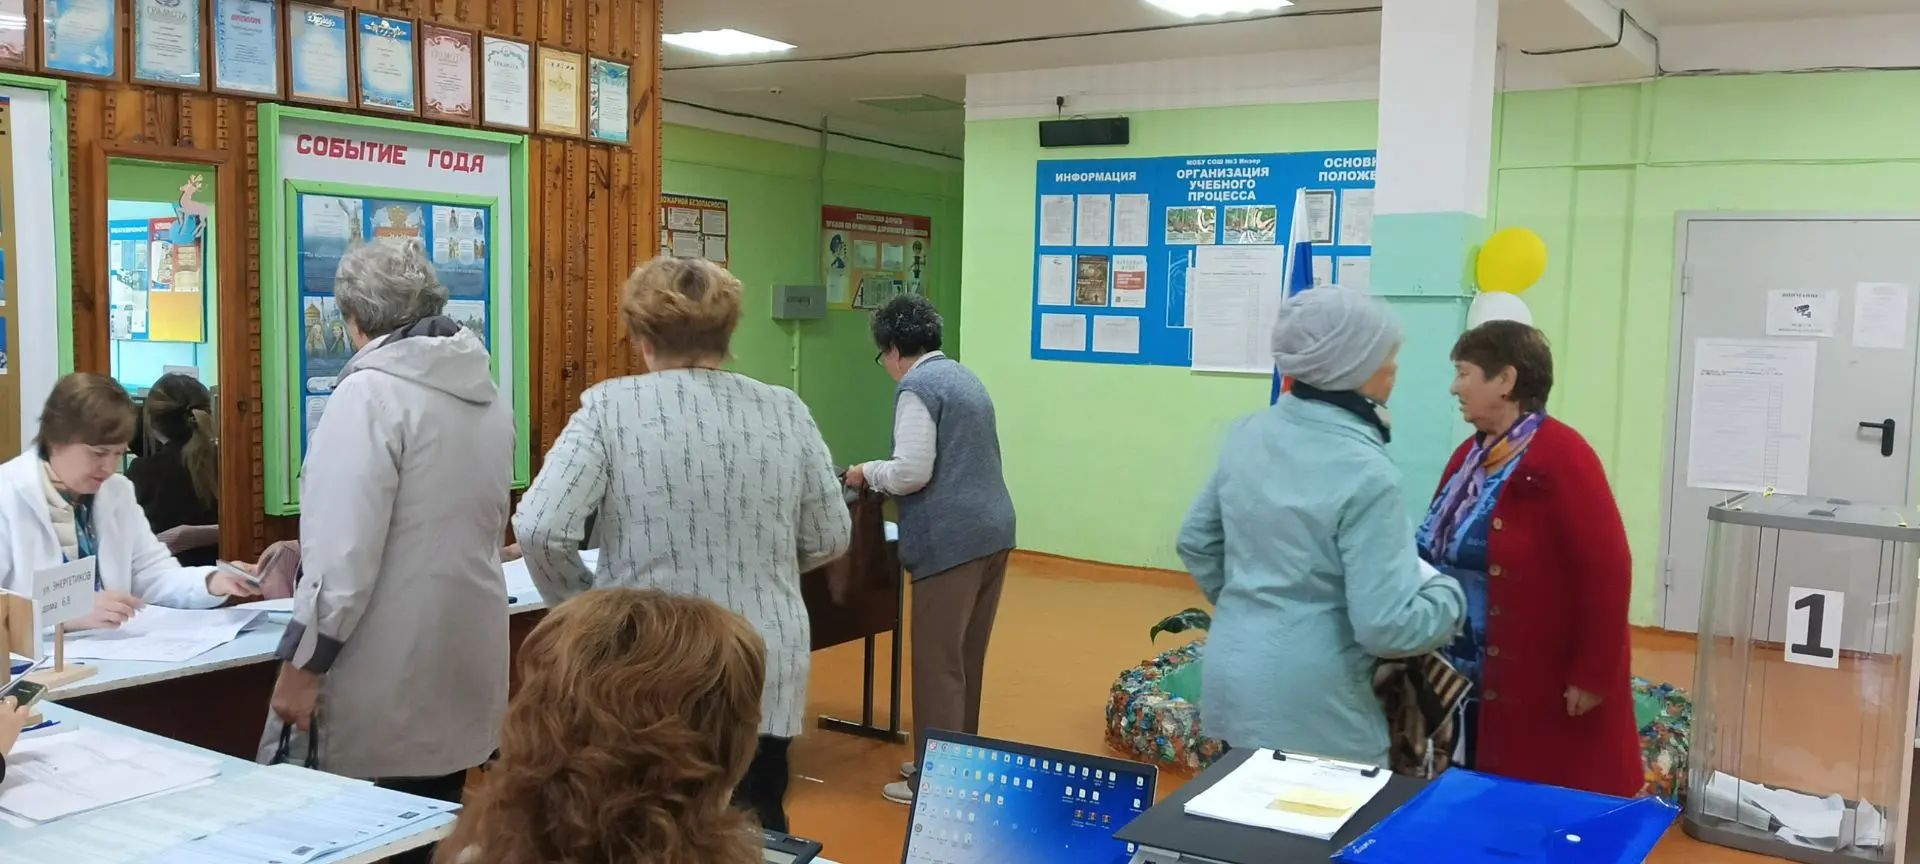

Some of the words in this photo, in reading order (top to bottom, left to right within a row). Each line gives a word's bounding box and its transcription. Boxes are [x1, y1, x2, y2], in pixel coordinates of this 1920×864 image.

[297, 134, 407, 165] СОБЫТИЕ
[1055, 171, 1137, 183] ИНФОРМАЦИЯ
[1176, 167, 1270, 179] ОРГАНИЗАЦИЯ
[1189, 179, 1256, 191] УЧЕБНОГО
[1187, 191, 1257, 202] ПРОЦЕССА
[1790, 593, 1834, 659] 1
